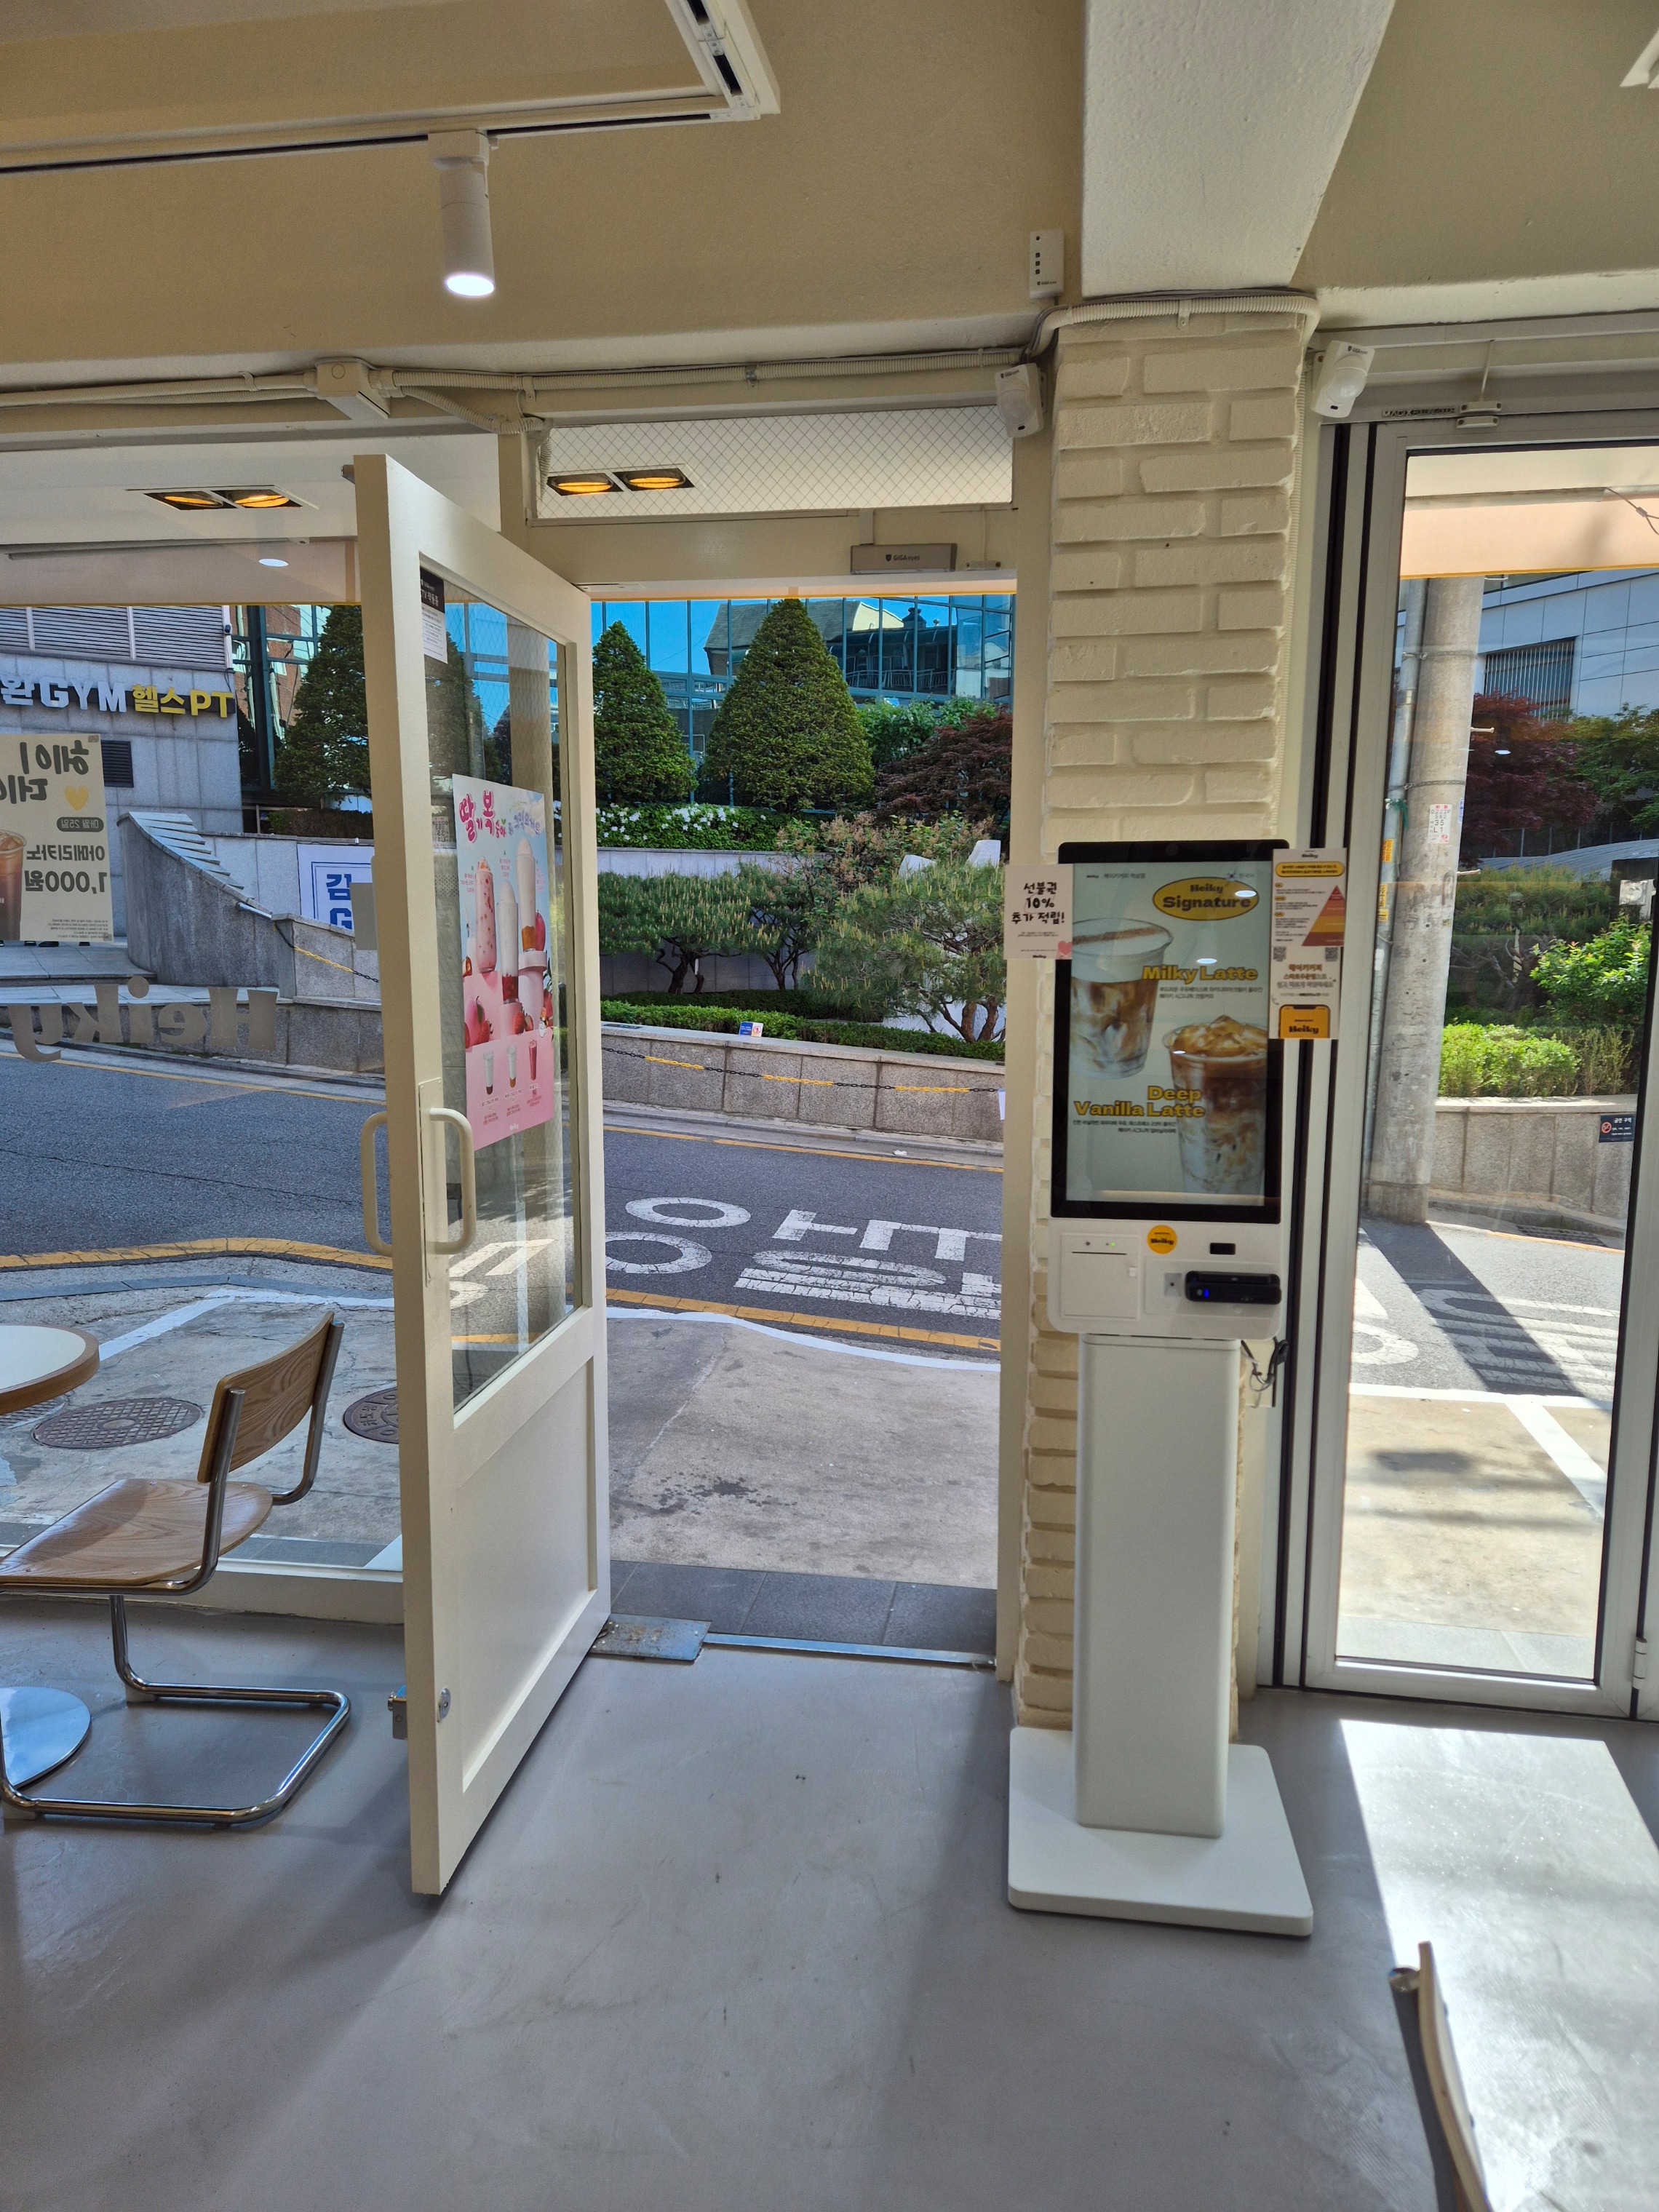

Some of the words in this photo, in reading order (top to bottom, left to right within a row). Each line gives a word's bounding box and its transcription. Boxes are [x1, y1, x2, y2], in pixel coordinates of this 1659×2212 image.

[1024, 881, 1057, 895] 선불권
[1190, 884, 1224, 894] Heiky
[1026, 897, 1055, 909] 10%
[1162, 896, 1252, 912] Signature
[1011, 912, 1035, 925] 추가
[1038, 911, 1065, 925] 적립!
[1142, 965, 1198, 985] Milky
[1200, 966, 1258, 981] Latte
[1289, 1025, 1319, 1034] Heiky
[1147, 1086, 1202, 1104] Deep
[1074, 1100, 1144, 1117] Vanilla
[1147, 1102, 1206, 1118] Latte
